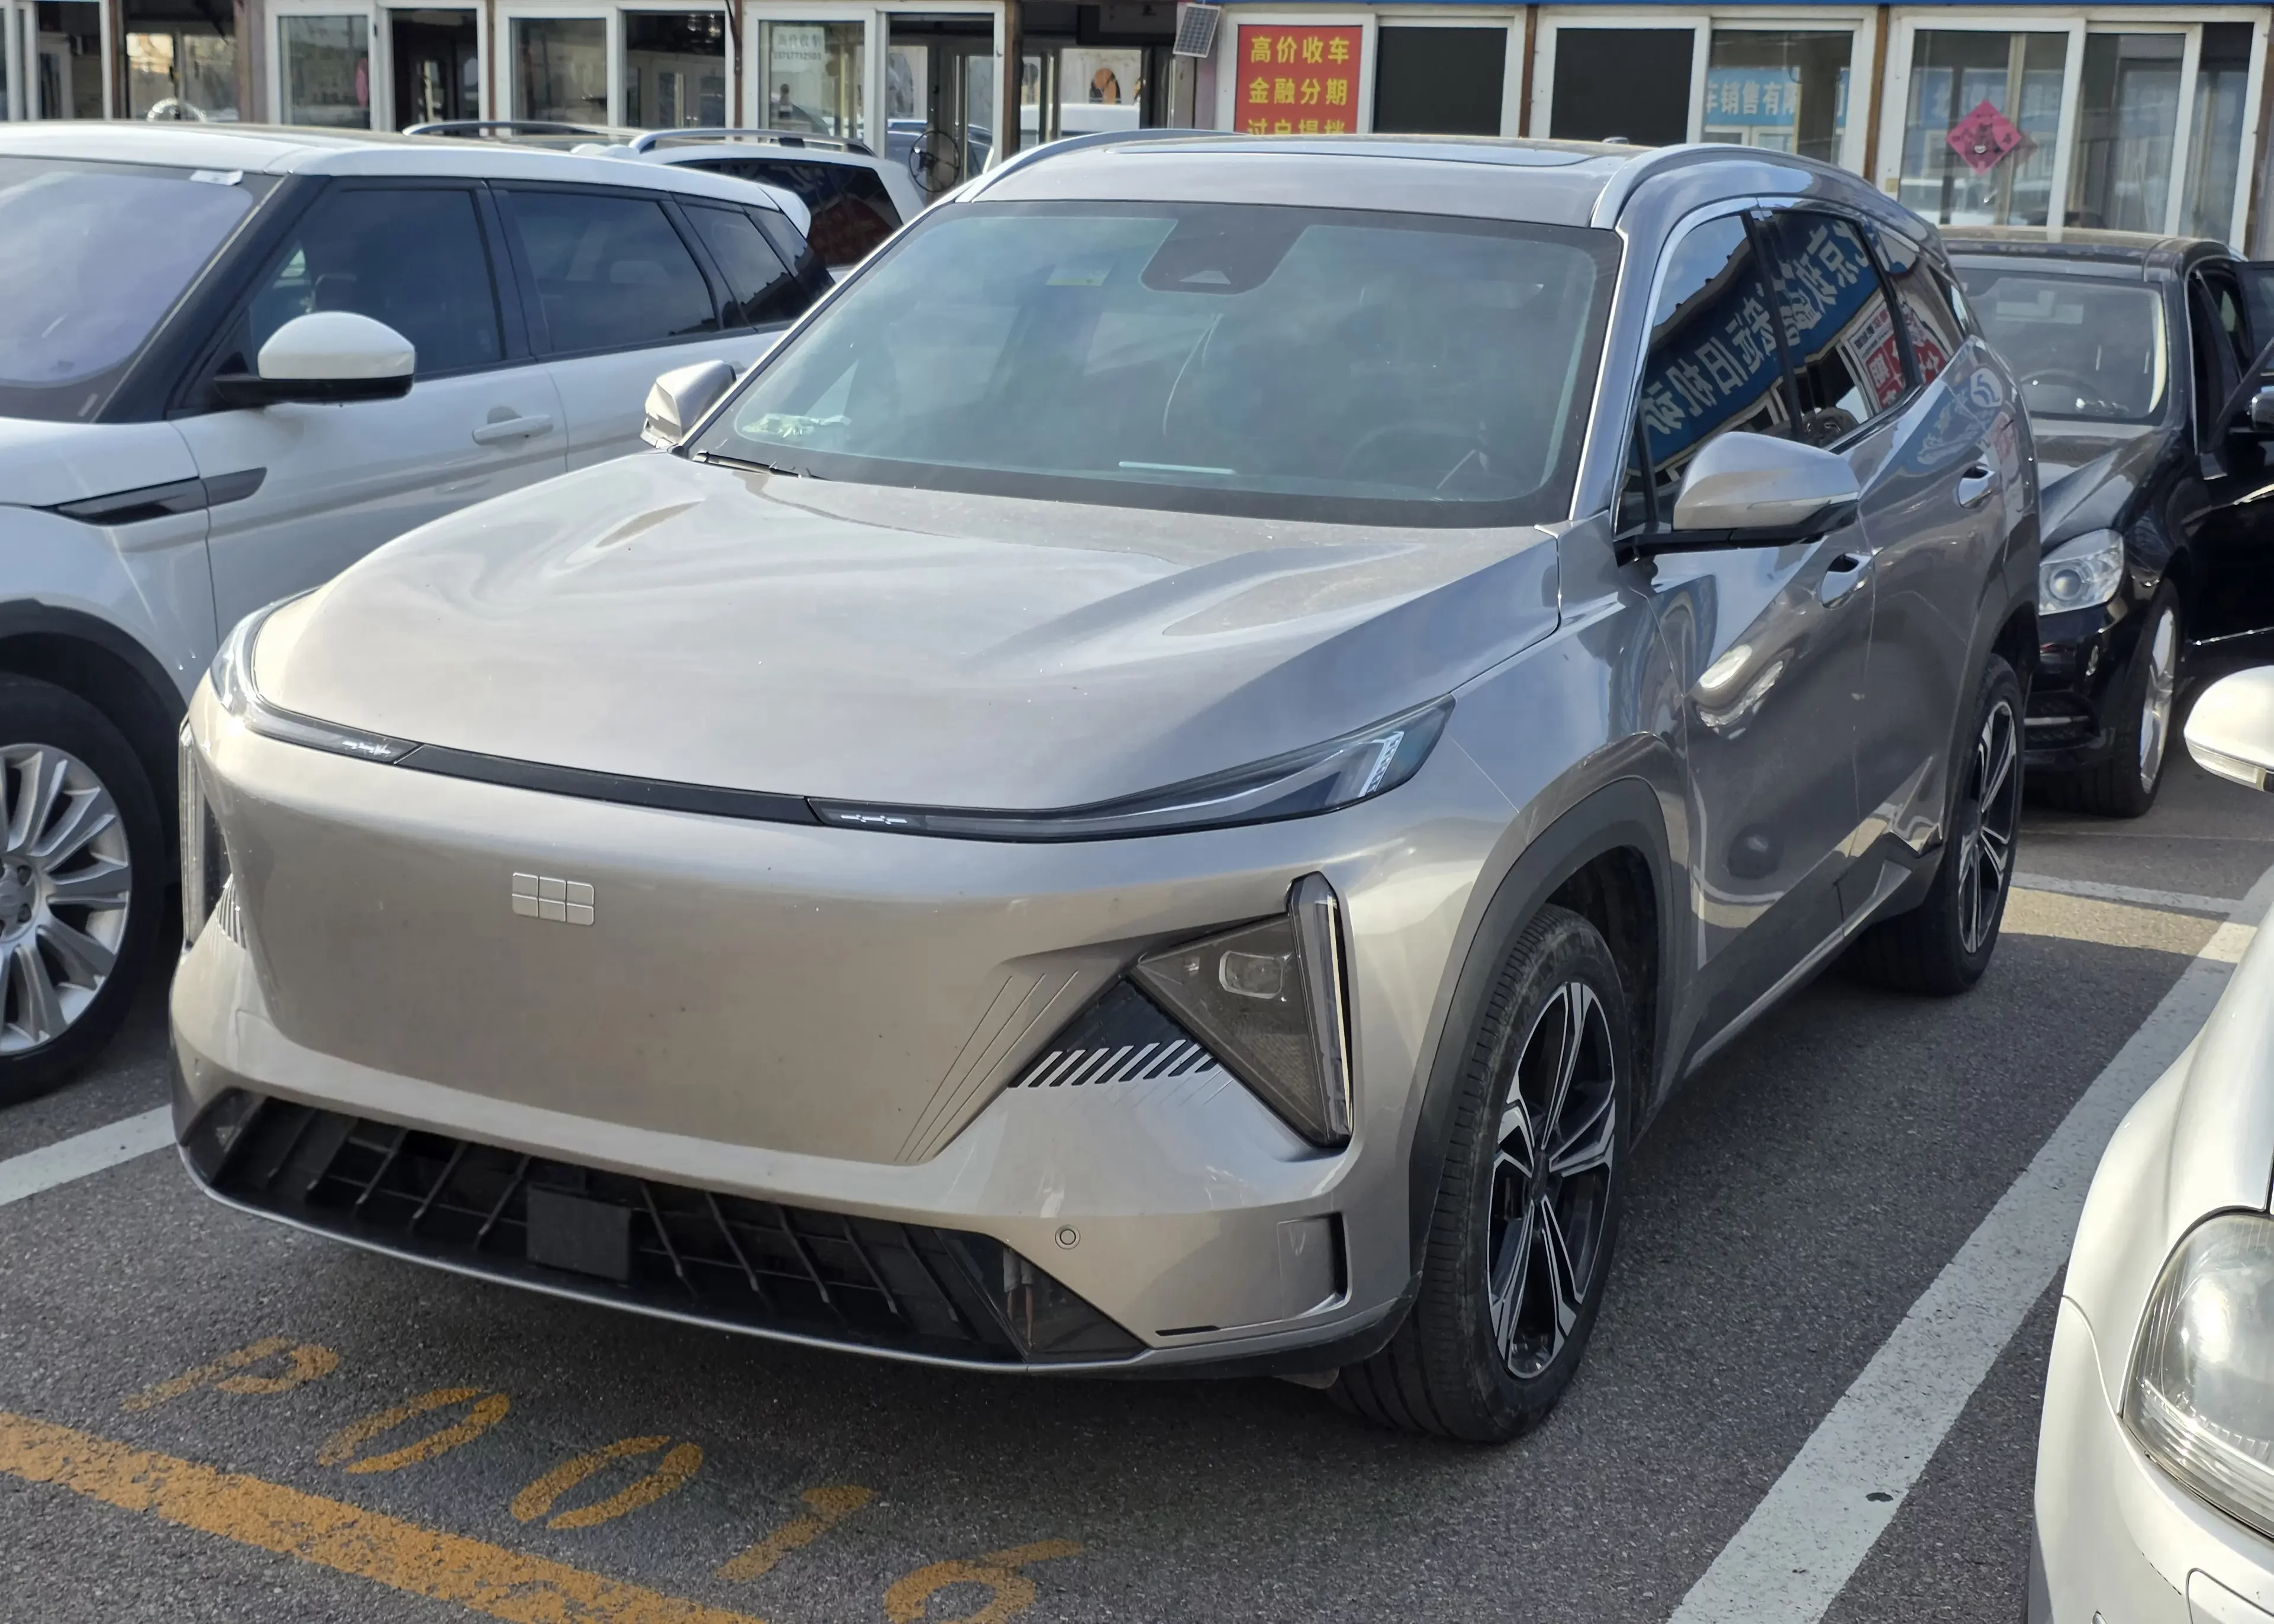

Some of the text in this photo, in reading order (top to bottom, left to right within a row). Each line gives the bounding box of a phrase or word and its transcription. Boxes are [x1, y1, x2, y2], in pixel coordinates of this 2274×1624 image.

[1250, 36, 1350, 65] 高价收车
[1248, 76, 1348, 105] 金融分期
